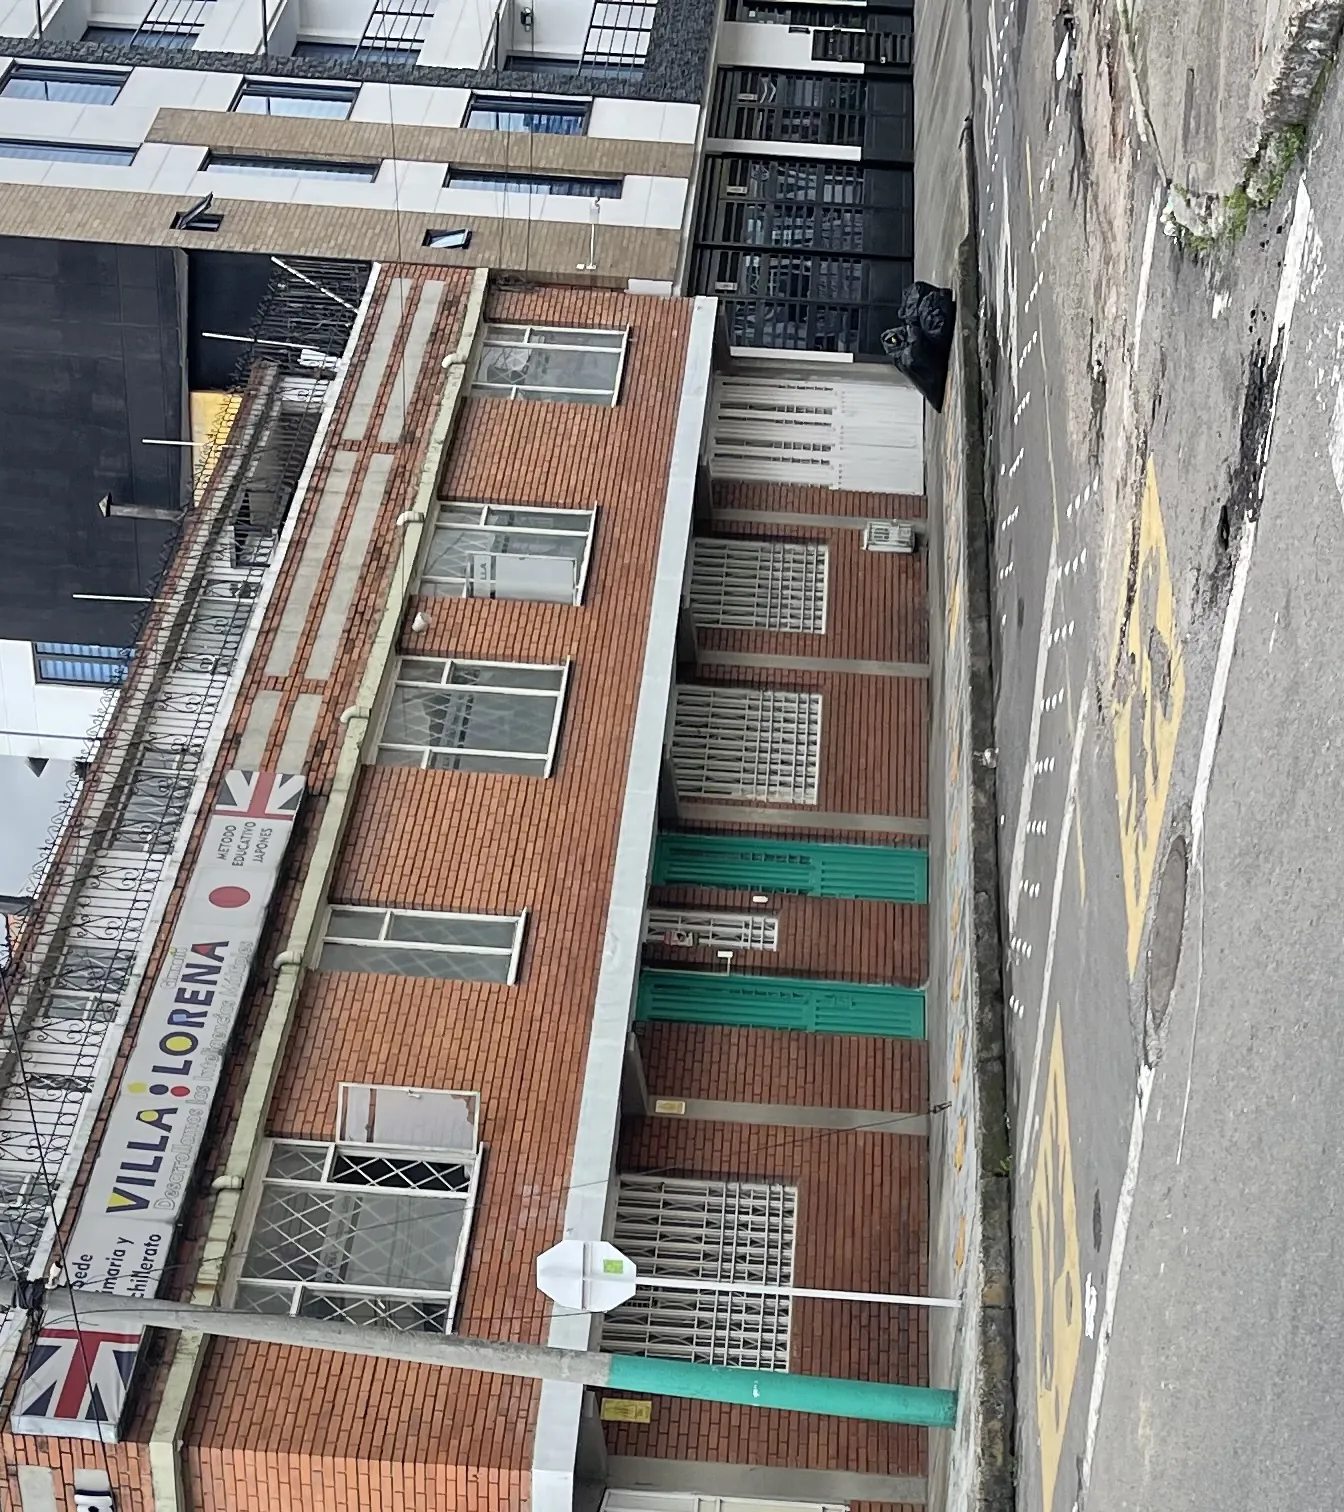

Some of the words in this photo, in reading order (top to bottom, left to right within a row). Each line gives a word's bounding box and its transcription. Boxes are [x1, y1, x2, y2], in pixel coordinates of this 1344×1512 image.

[216, 825, 236, 860] METODO
[231, 821, 256, 866] EDUCATIVO
[252, 827, 273, 863] JAPONES
[106, 1107, 178, 1213] VILLA
[151, 941, 229, 1076] LORENA
[154, 1108, 203, 1210] Desarrollamos
[95, 1249, 126, 1294] imaria
[117, 1236, 134, 1244] y
[127, 1234, 161, 1298] chillerato
